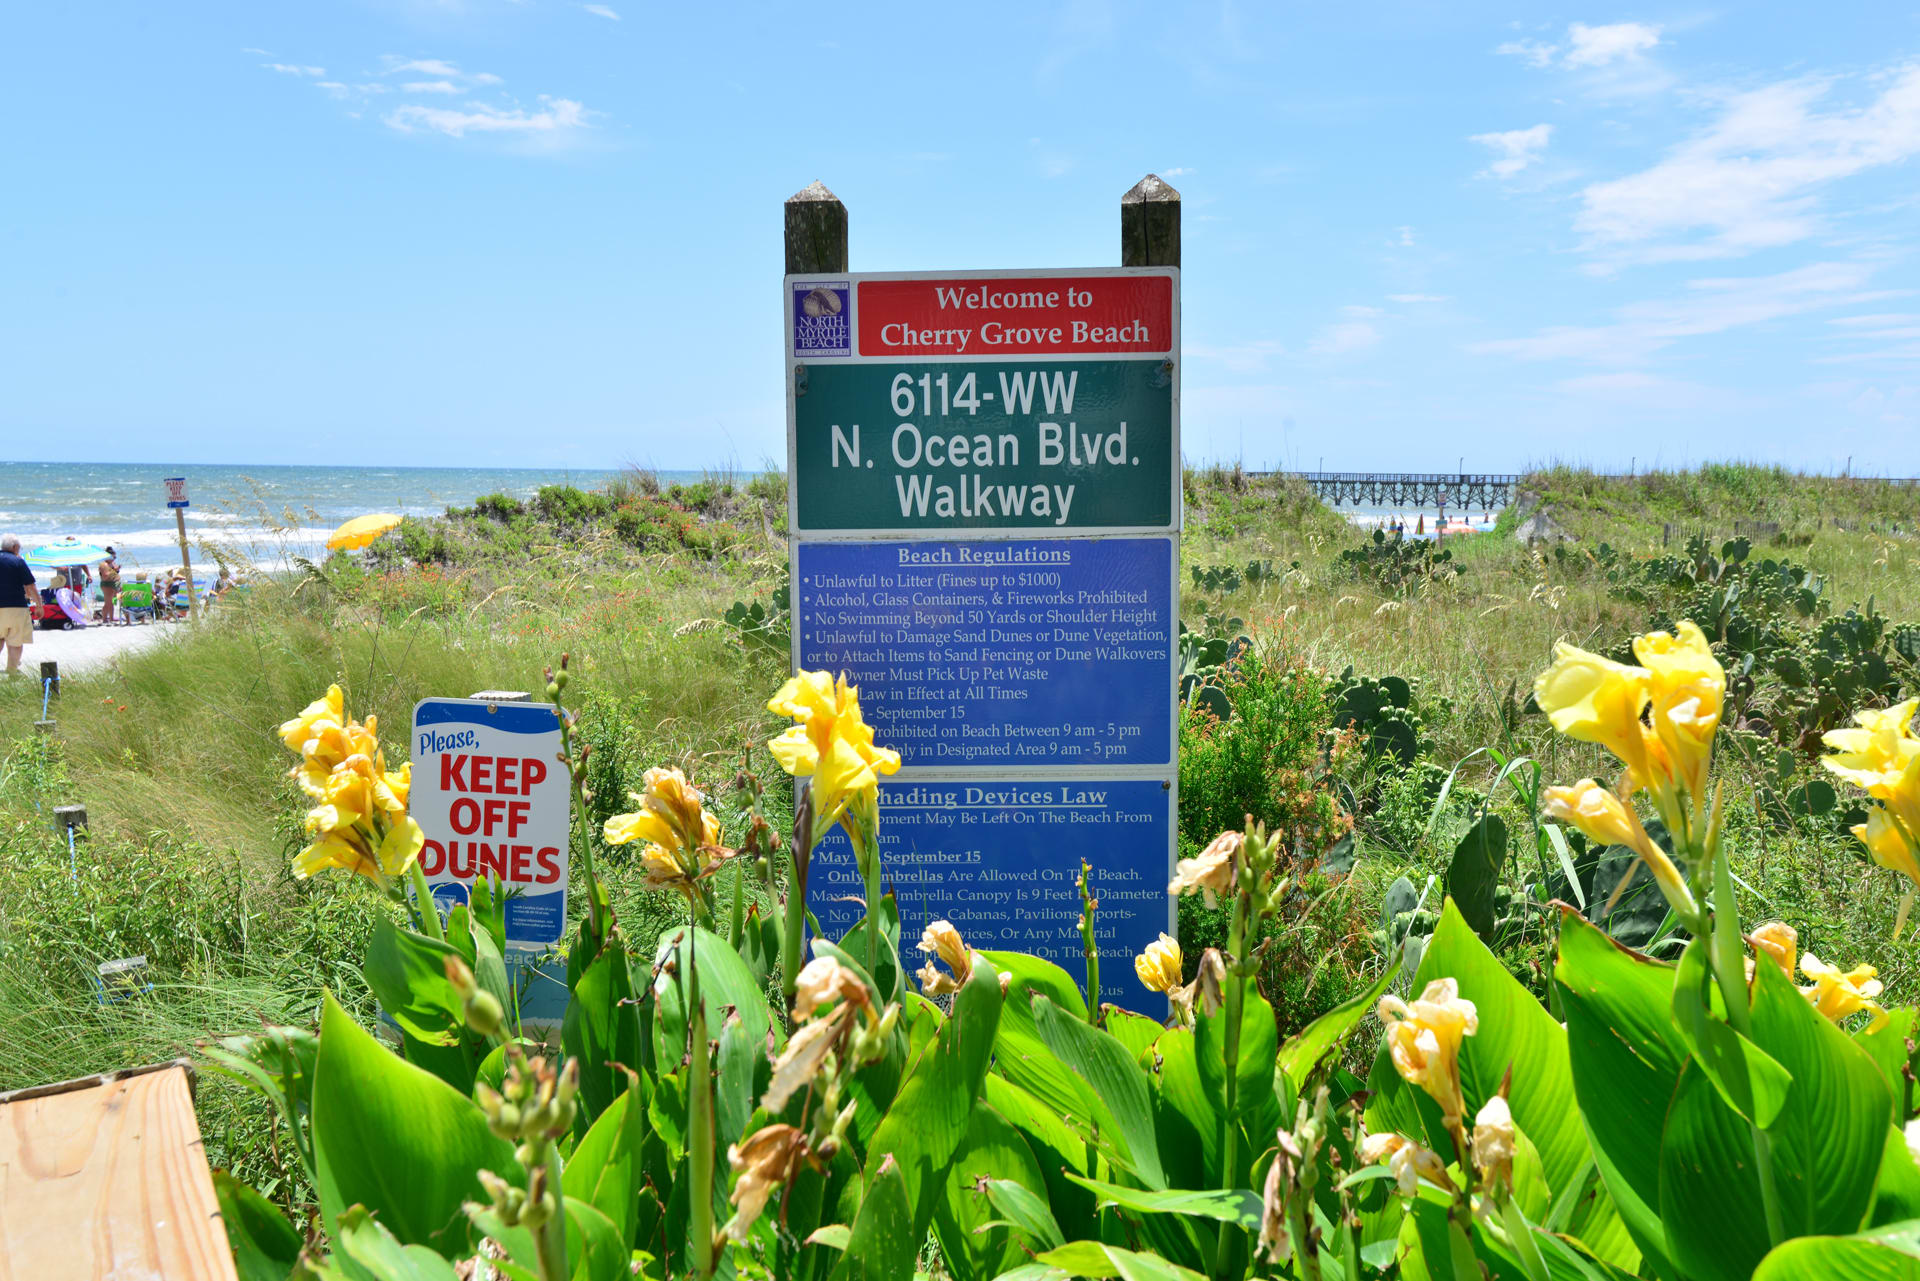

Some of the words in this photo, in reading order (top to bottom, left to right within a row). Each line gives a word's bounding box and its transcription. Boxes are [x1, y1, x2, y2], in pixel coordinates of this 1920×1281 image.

[936, 287, 1061, 309] Welcome
[1067, 286, 1093, 307] to
[800, 316, 844, 329] NORTH
[798, 327, 847, 339] MYRTLE
[881, 323, 973, 352] Cherry
[981, 321, 1063, 344] Grove
[1071, 320, 1150, 343] Beach
[802, 337, 843, 348] BEACH
[891, 371, 1079, 416] 6114-WW
[831, 425, 874, 468] N.
[892, 423, 1019, 468] Ocean
[1038, 421, 1140, 466] Blvd.
[895, 474, 1076, 525] Walkway
[899, 548, 952, 564] Beach
[959, 547, 1071, 566] Regulations
[814, 574, 876, 588] Unlawful
[881, 576, 893, 588] to
[898, 574, 933, 588] Litter
[937, 574, 976, 590] (Fines
[981, 577, 998, 589] up
[1002, 575, 1015, 586] to
[1018, 573, 1061, 589] $1000)
[814, 592, 870, 608] Alcohol,
[873, 592, 908, 606] Glass
[912, 592, 988, 607] Containers,
[992, 593, 1004, 605] &
[1007, 591, 1073, 604] Fireworks
[1078, 590, 1147, 604] Prohibited
[815, 613, 835, 625] No
[839, 612, 910, 628] Swimming
[914, 611, 964, 627] Beyond
[968, 611, 983, 624] 50
[987, 610, 1026, 623] Yards
[1030, 614, 1043, 623] or
[1046, 609, 1107, 623] Shoulder
[1111, 609, 1157, 625] Height
[815, 630, 876, 644] Unlawful
[881, 632, 893, 643] to
[897, 631, 950, 647] Damage
[953, 629, 986, 643] Sand
[990, 630, 1032, 642] Dunes
[1036, 633, 1050, 642] or
[1054, 629, 1089, 642] Dune
[1094, 628, 1167, 645] Vegetation,
[807, 652, 821, 662] or
[824, 651, 838, 662] to
[841, 649, 884, 662] Attach
[889, 649, 924, 662] Items
[928, 650, 941, 662] to
[944, 648, 978, 661] Sand
[982, 648, 1033, 665] Fencing
[1037, 651, 1051, 661] or
[1055, 647, 1092, 660] Dune
[1096, 646, 1166, 660] Walkovers
[890, 668, 923, 681] Must
[928, 668, 956, 681] Pick
[959, 668, 980, 684] Up
[983, 668, 1003, 681] Pet
[1007, 668, 1048, 680] Waste
[859, 687, 886, 700] Law
[890, 687, 904, 700] in
[908, 686, 944, 700] Effect
[948, 689, 962, 699] at
[965, 686, 984, 699] All
[988, 686, 1028, 699] Times
[876, 705, 947, 723] September
[950, 706, 965, 719] 15
[941, 727, 958, 737] on
[962, 723, 1000, 737] Beach
[1004, 723, 1060, 736] Between
[1063, 724, 1071, 737] 9
[1074, 726, 1095, 736] am
[1107, 723, 1115, 736] 5
[1119, 725, 1141, 739] pm
[419, 730, 480, 755] Please,
[920, 743, 933, 756] in
[937, 742, 1010, 758] Designated
[1015, 742, 1046, 755] Area
[1049, 742, 1057, 755] 9
[1060, 745, 1081, 755] am
[1093, 742, 1101, 755] 5
[1105, 744, 1127, 758] pm
[440, 753, 547, 796] KEEP
[879, 788, 957, 807] hading
[966, 788, 1055, 804] Devices
[1062, 788, 1107, 804] Law
[449, 797, 531, 838] OFF
[925, 812, 957, 828] May
[961, 812, 978, 824] Be
[981, 812, 1008, 823] Left
[1013, 812, 1035, 823] On
[1039, 812, 1065, 823] The
[1070, 811, 1111, 823] Beach
[1115, 811, 1152, 823] From
[417, 838, 561, 884] DUNES
[818, 851, 850, 866] May
[883, 850, 961, 867] September
[965, 850, 981, 863] 15
[827, 870, 864, 885] Only
[880, 870, 943, 882] mbrellas
[948, 870, 973, 881] Are
[980, 869, 1037, 881] Allowed
[1041, 869, 1061, 881] On
[1098, 868, 1142, 881] Beach.
[957, 889, 1011, 904] Canopy
[1016, 889, 1028, 900] Is
[1031, 889, 1040, 900] 9
[1044, 888, 1072, 899] Feet
[1096, 887, 1164, 900] Diameter.
[828, 909, 850, 921] No
[948, 908, 1010, 923] Cabanas,
[1096, 909, 1136, 922] ports-
[1000, 928, 1020, 939] Or
[1025, 927, 1054, 943] Any
[1058, 926, 1116, 939] Marial
[1037, 947, 1059, 959] On
